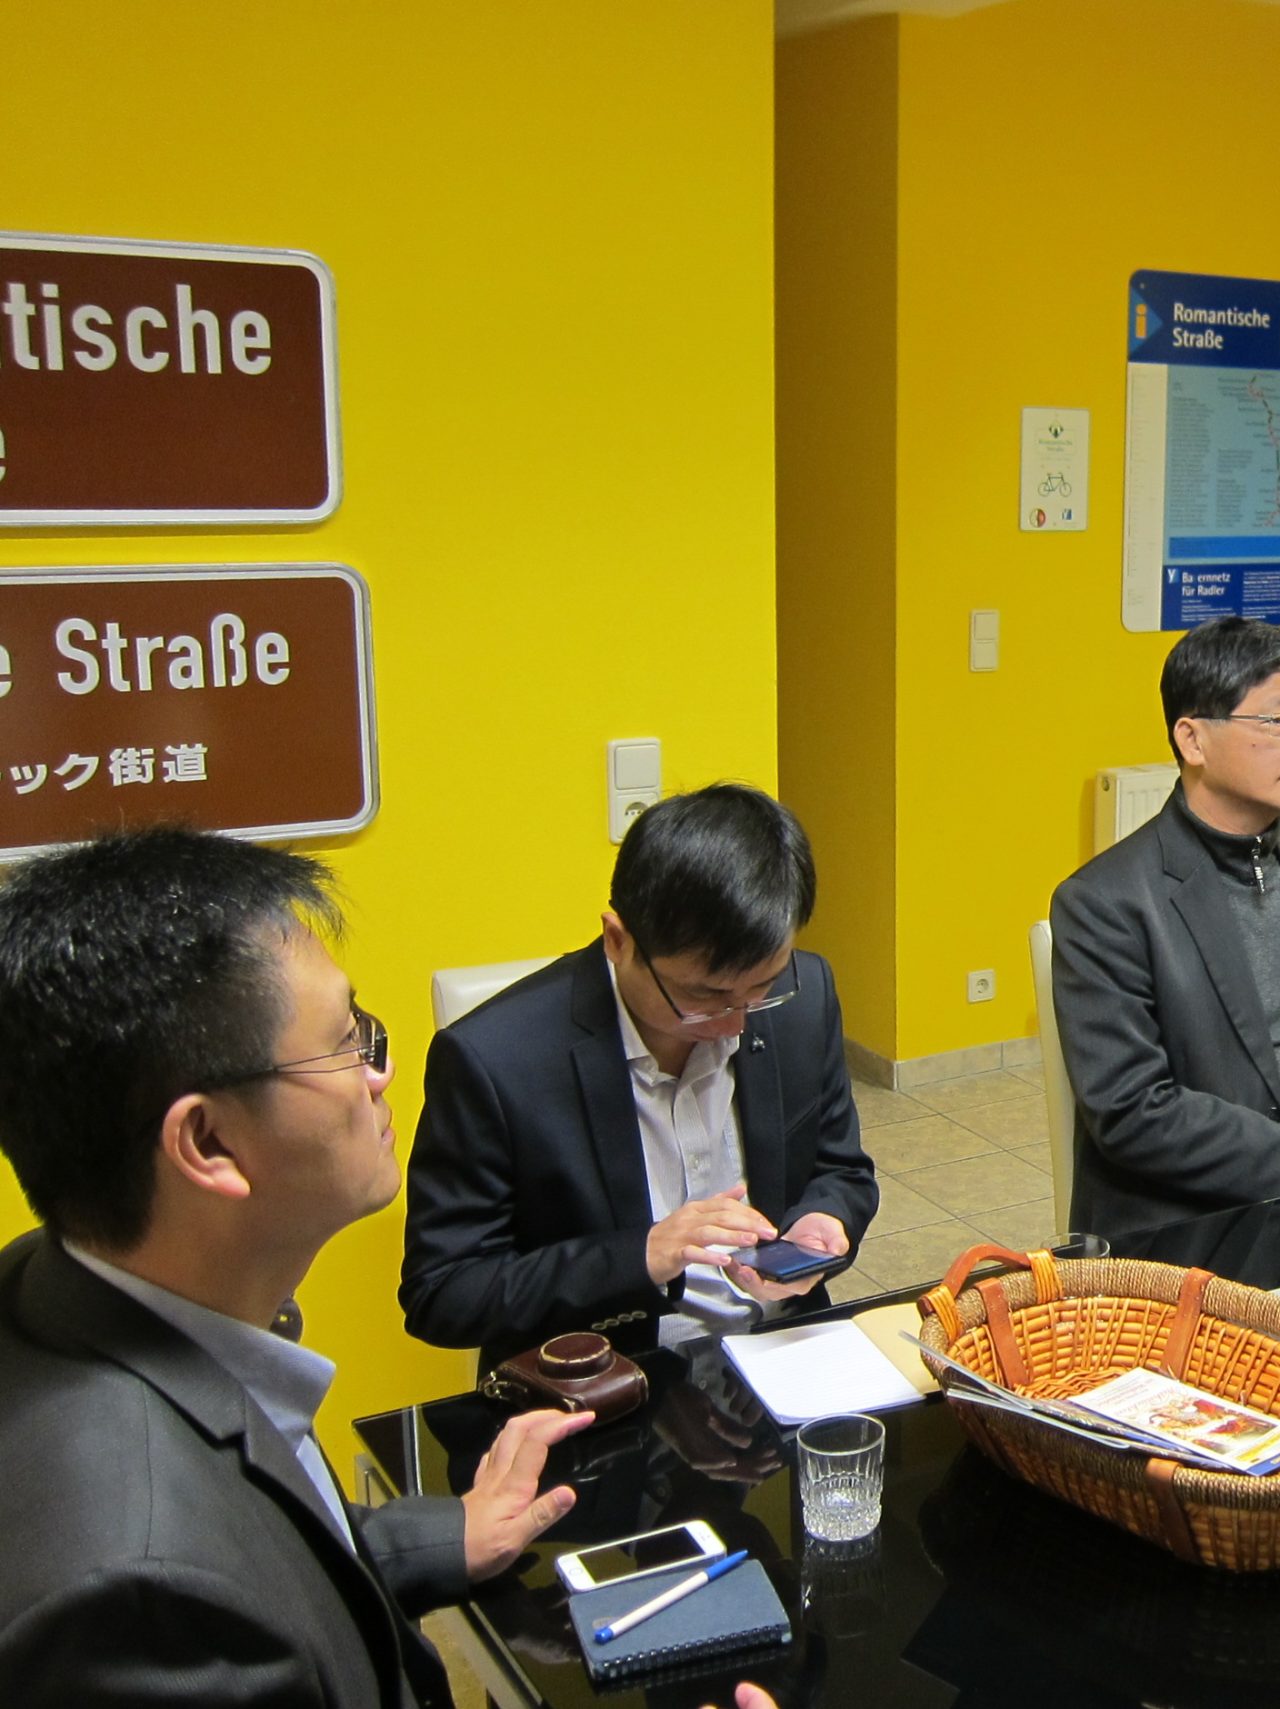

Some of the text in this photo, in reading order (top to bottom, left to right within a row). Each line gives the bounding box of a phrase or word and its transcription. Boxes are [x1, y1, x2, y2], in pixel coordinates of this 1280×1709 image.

[0, 283, 272, 375] tische
[1173, 303, 1271, 328] Romantische
[1172, 327, 1224, 349] Straße
[1182, 585, 1225, 596] für Radler
[55, 613, 290, 695] Straße
[0, 743, 208, 795] ック街道
